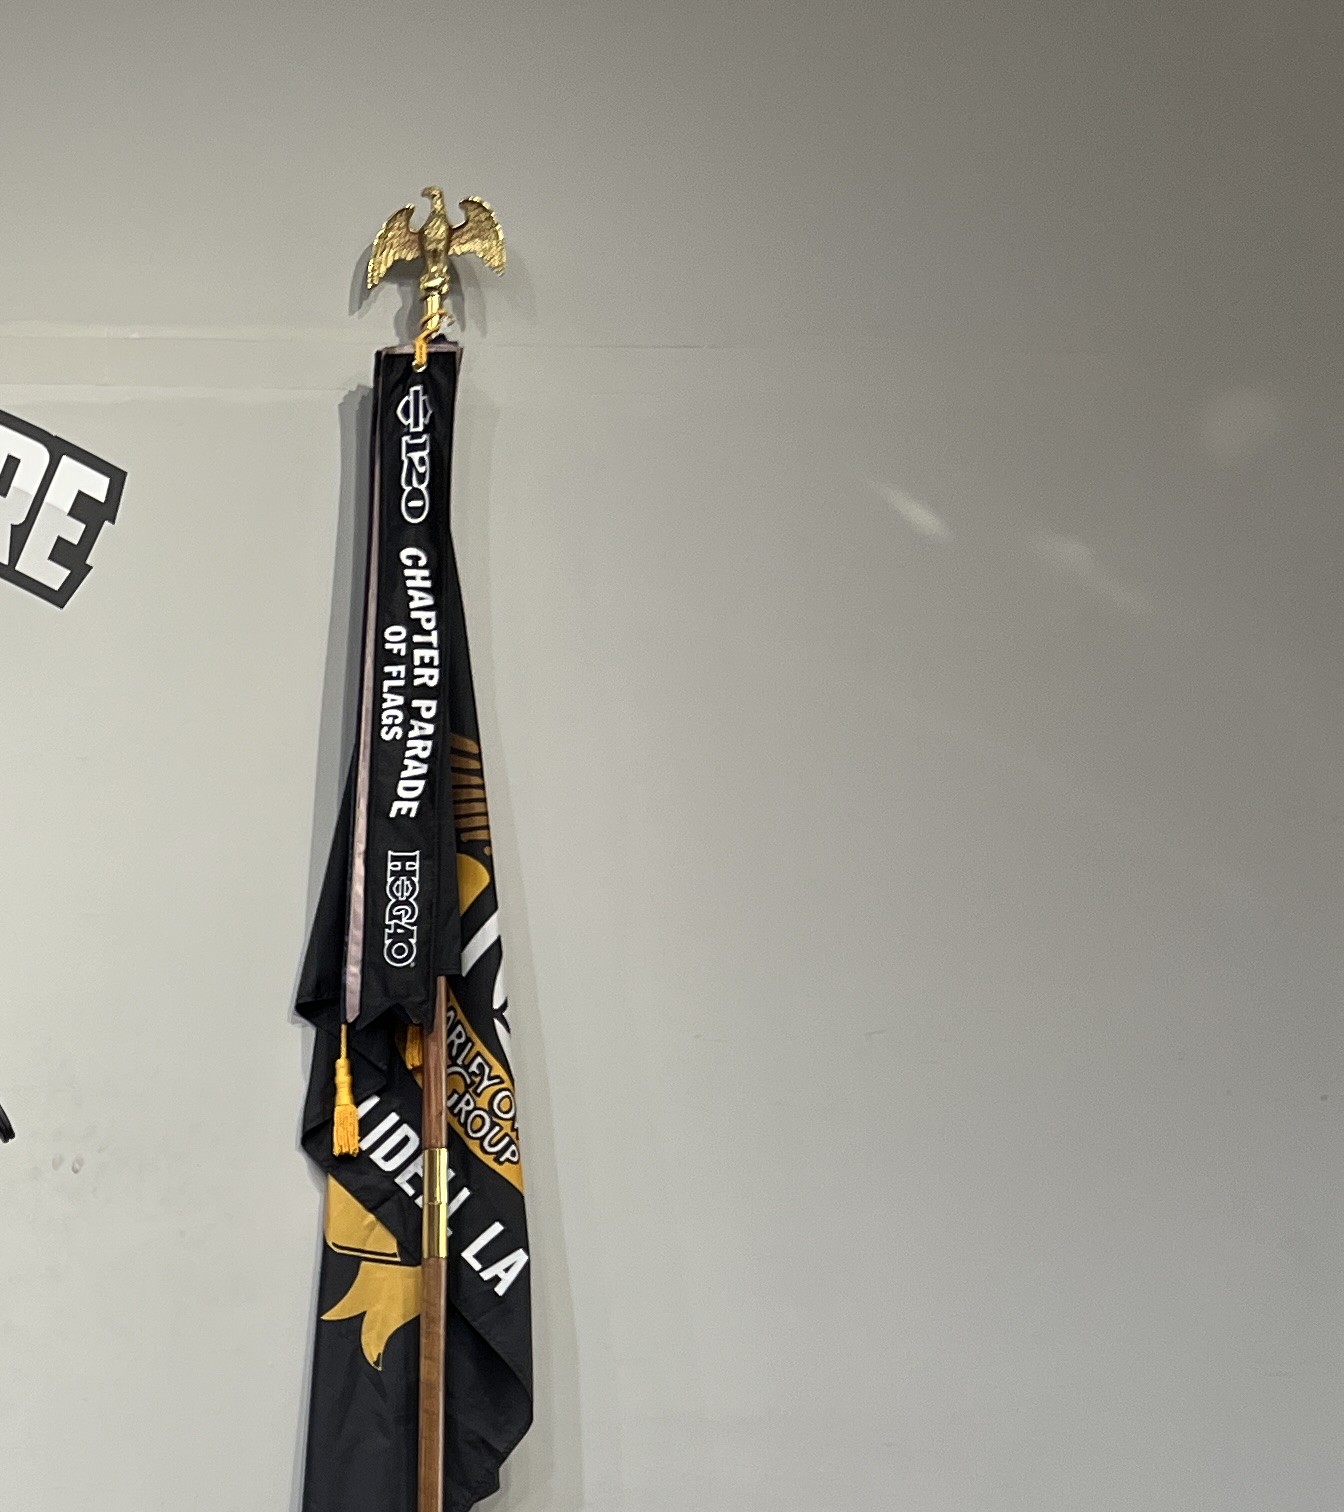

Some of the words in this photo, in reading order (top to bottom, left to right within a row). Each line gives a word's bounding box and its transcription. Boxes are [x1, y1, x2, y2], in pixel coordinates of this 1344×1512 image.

[383, 624, 407, 656] OF
[399, 546, 440, 688] CHAPTER
[380, 664, 407, 742] FLAGS
[389, 699, 438, 818] PARADE
[446, 1009, 501, 1094] ARLEY
[461, 1220, 529, 1297] LA
